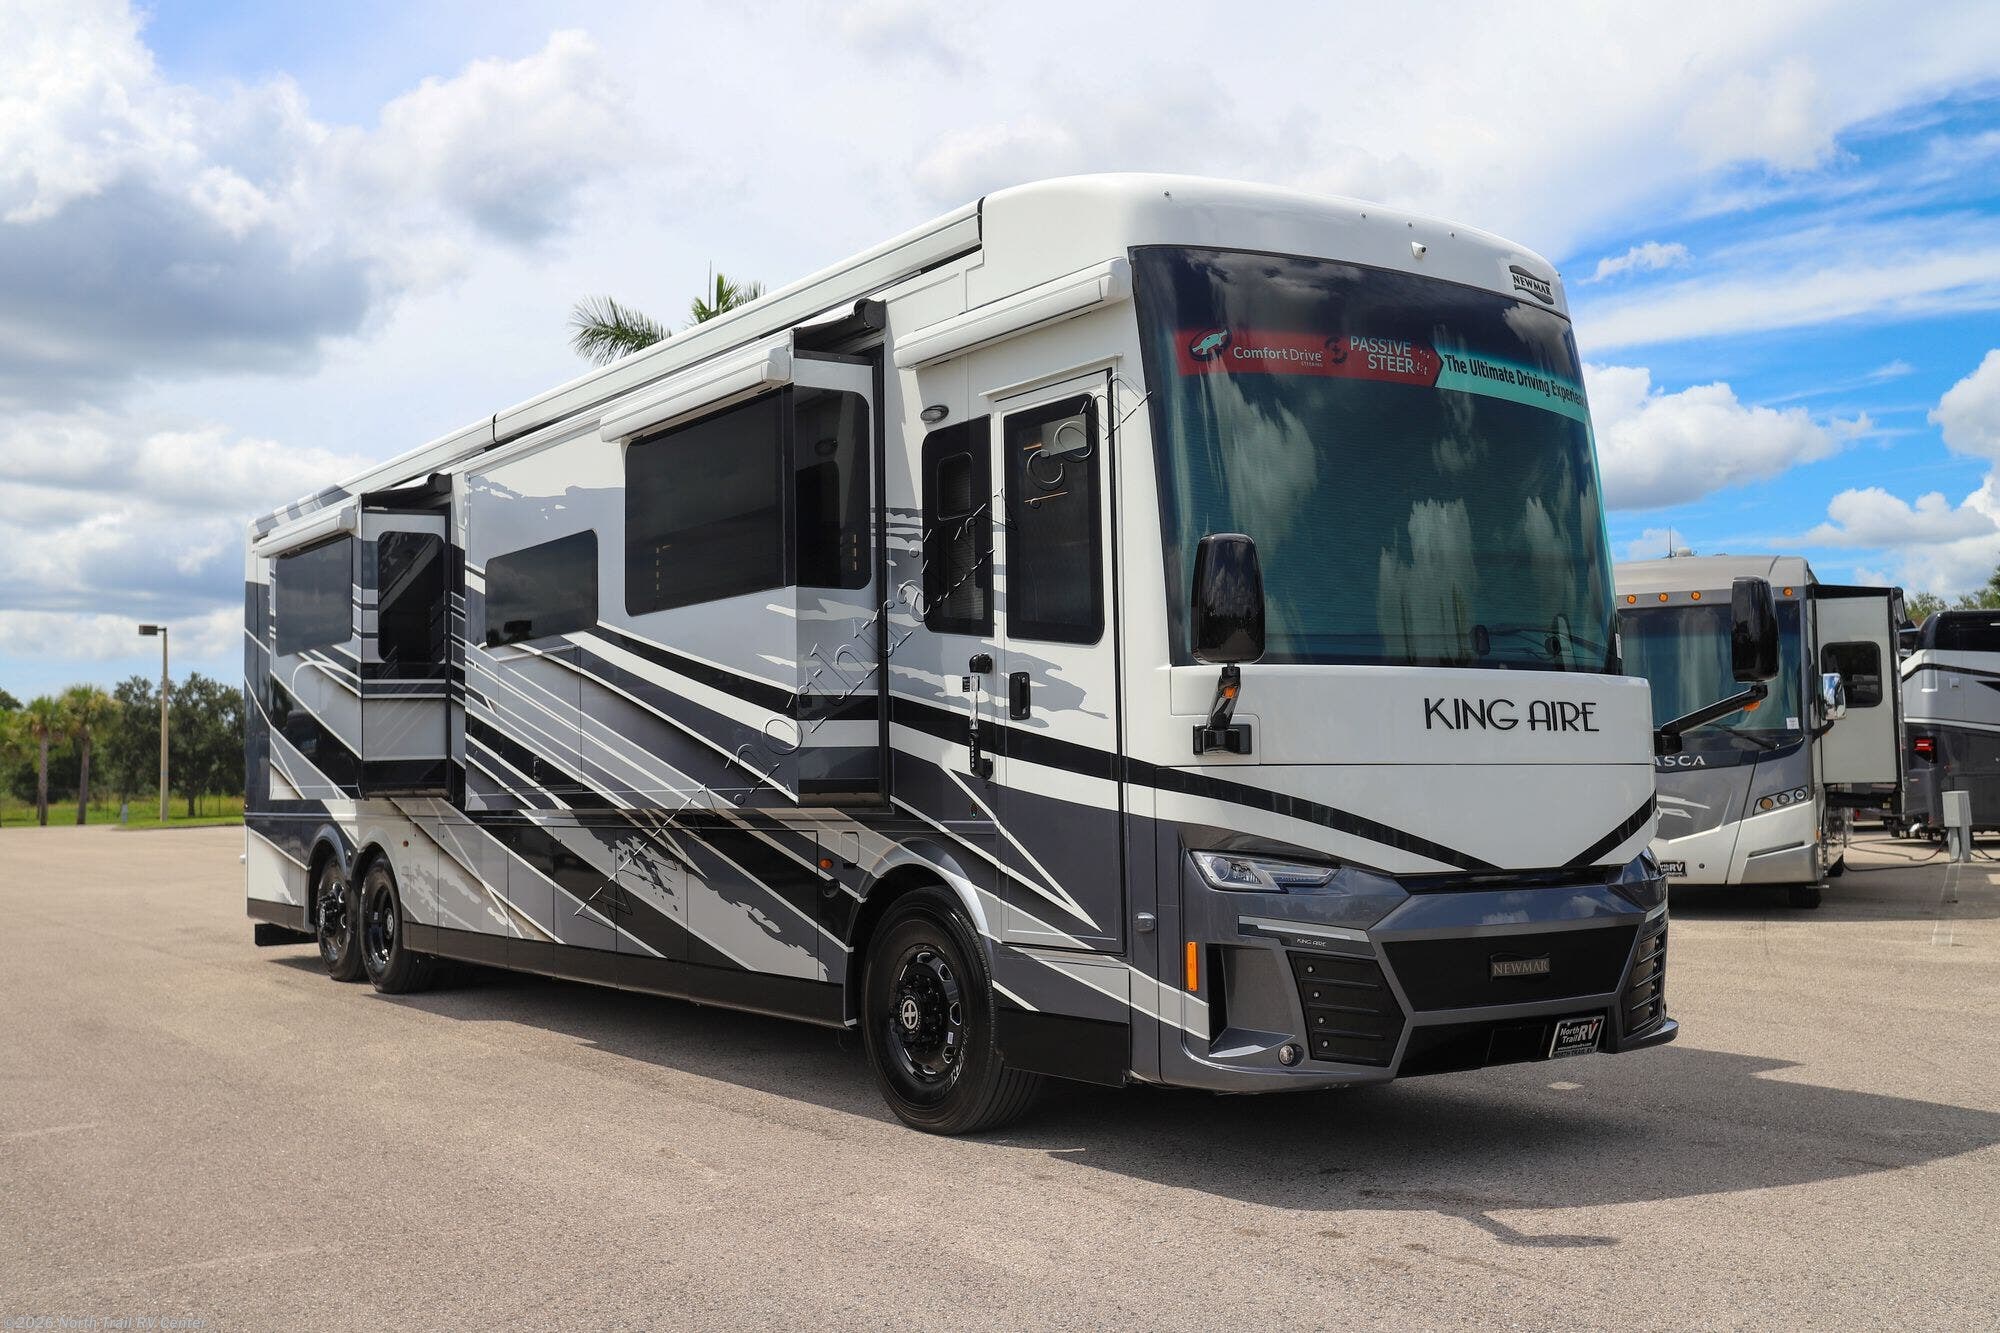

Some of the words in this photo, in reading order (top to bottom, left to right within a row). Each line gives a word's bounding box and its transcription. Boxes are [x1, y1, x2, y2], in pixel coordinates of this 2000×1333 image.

[1512, 273, 1553, 297] NEWMAR
[1233, 346, 1288, 360] Comfort
[1289, 348, 1323, 361] Drive
[1350, 335, 1411, 357] PASSIVE
[1367, 353, 1415, 374] STEER
[1444, 354, 1468, 374] The
[1469, 358, 1515, 385] Ultimate
[1515, 369, 1550, 397] Driving
[1424, 698, 1519, 731] KING
[1527, 700, 1600, 732] AIRE
[1494, 960, 1548, 975] NEWMAR
[1560, 1026, 1580, 1037] North
[1562, 1034, 1579, 1044] Trail
[1578, 1023, 1599, 1041] RV
